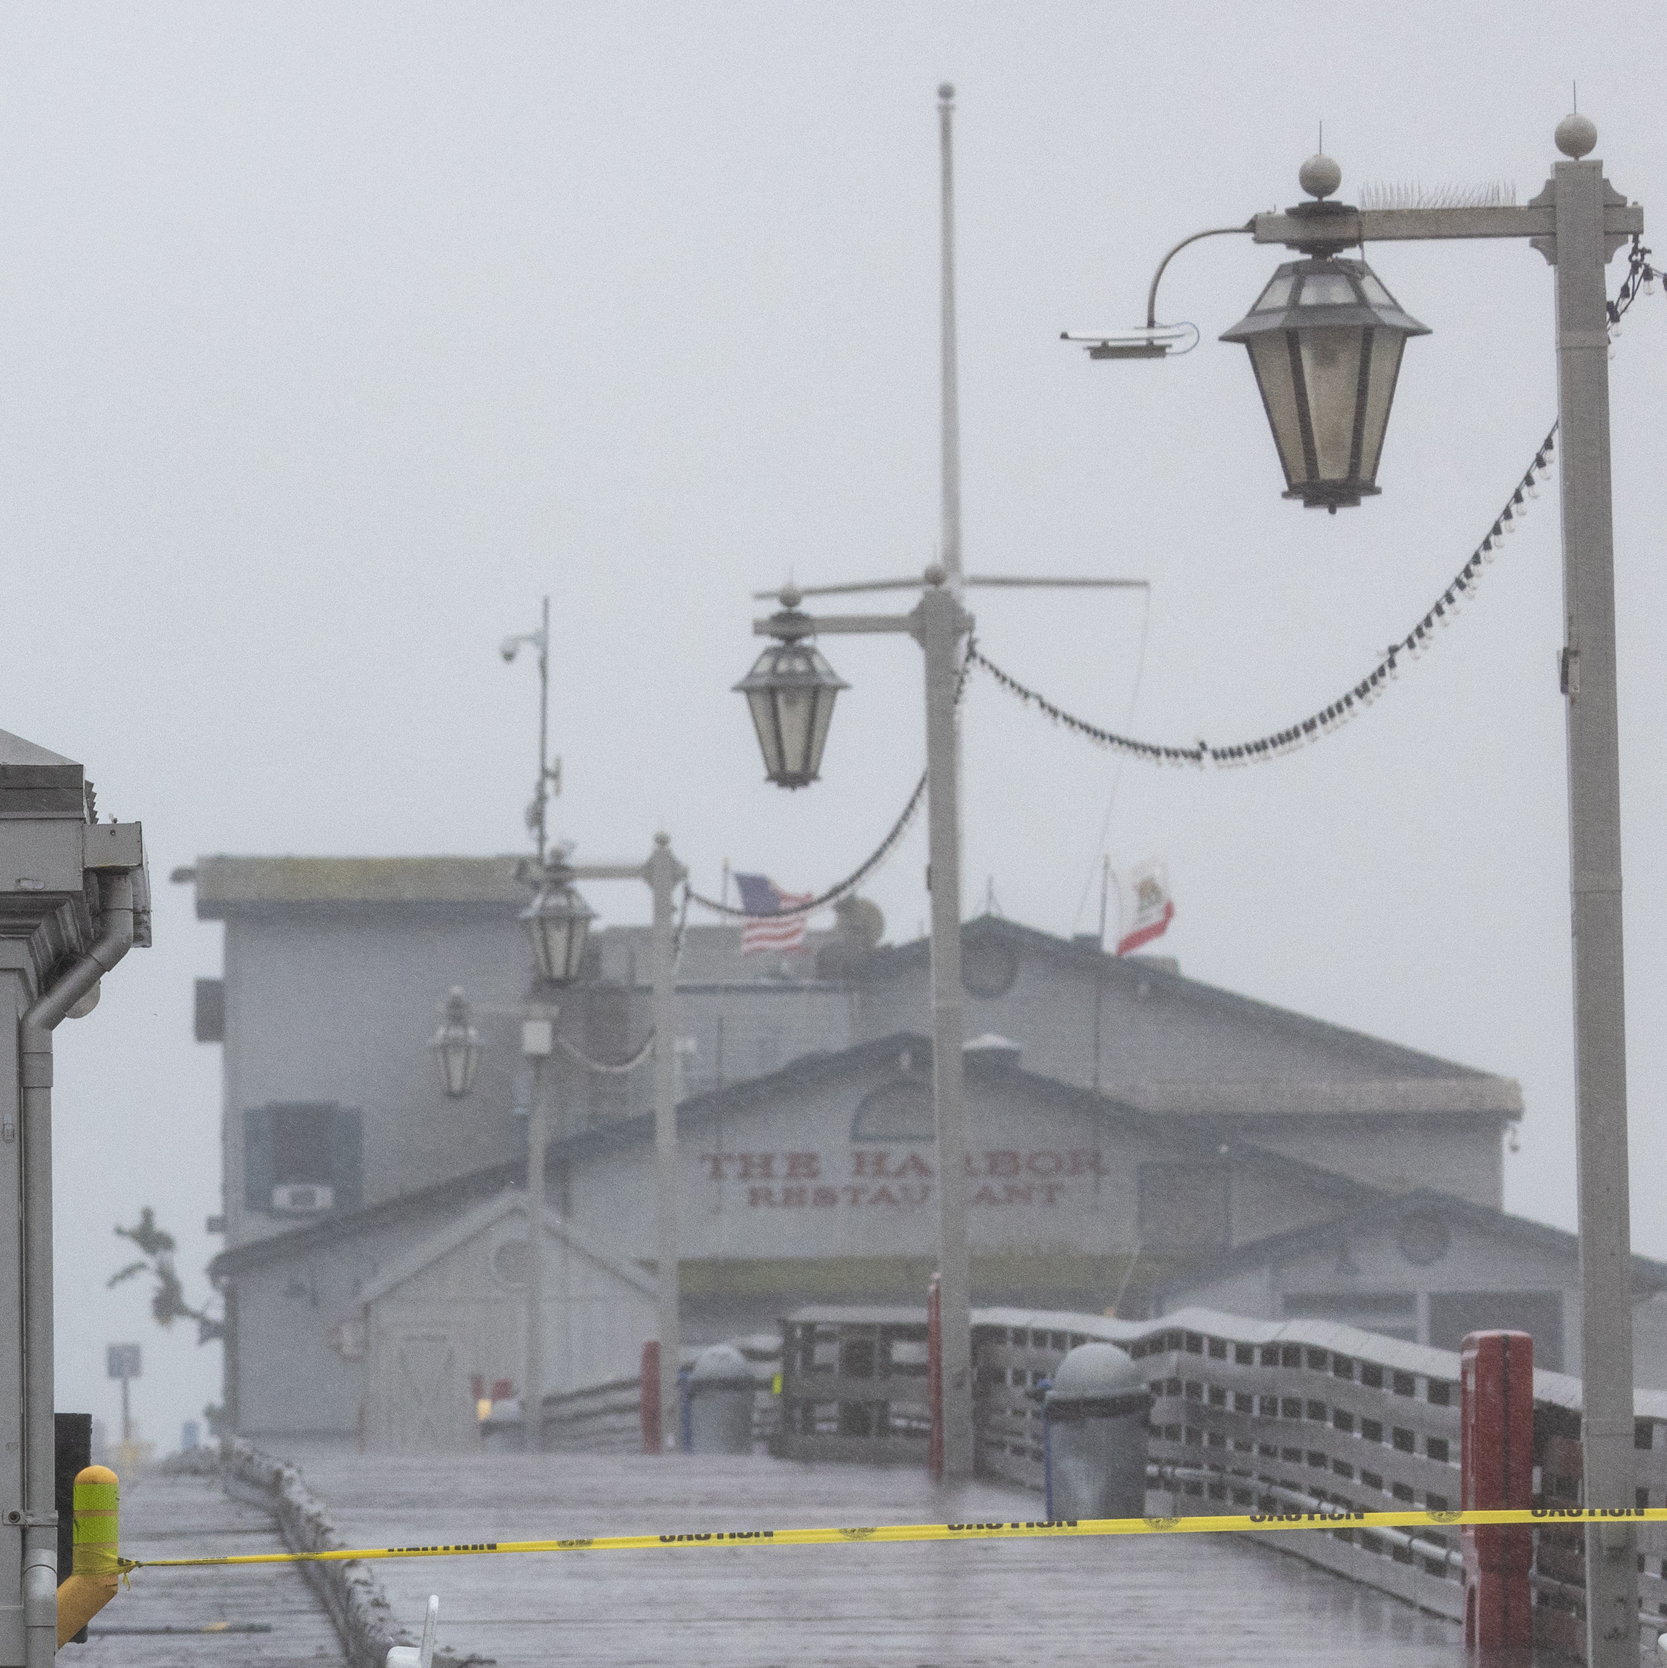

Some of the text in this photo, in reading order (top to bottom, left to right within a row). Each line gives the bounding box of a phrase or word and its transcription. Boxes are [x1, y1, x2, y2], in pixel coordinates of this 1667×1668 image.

[700, 1149, 1110, 1181] THE HABOR
[746, 1183, 1065, 1209] RESTAUANT
